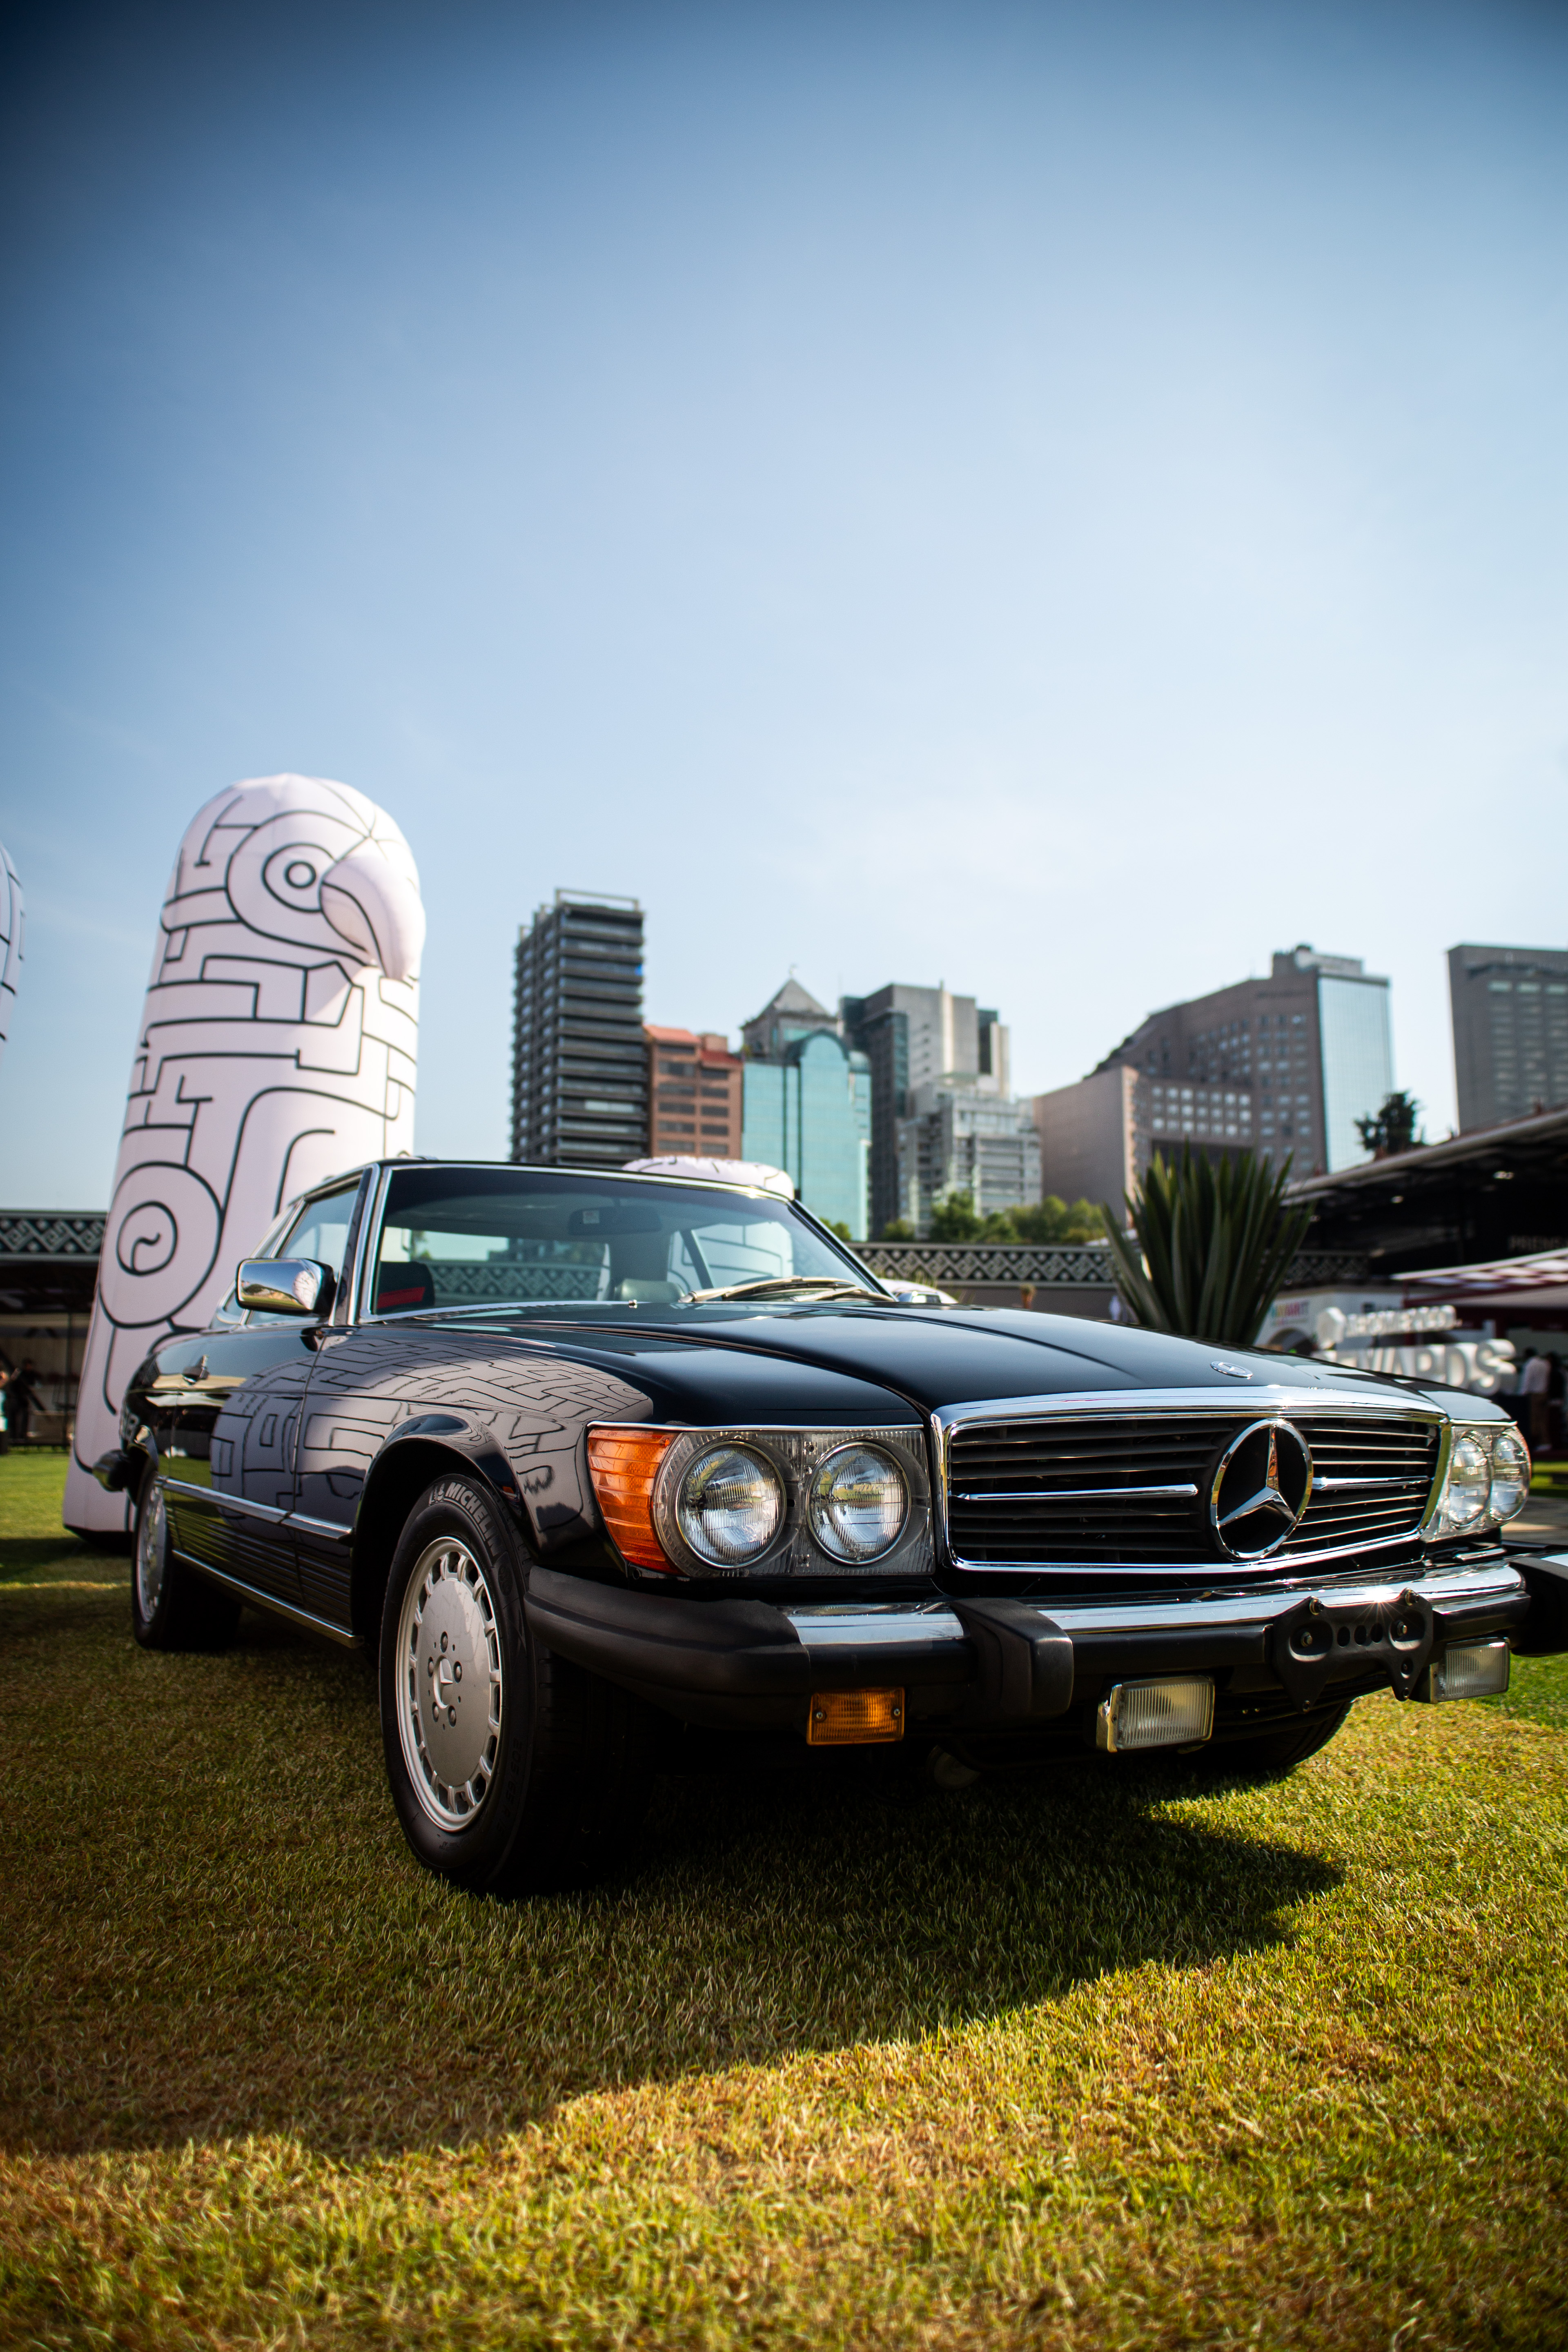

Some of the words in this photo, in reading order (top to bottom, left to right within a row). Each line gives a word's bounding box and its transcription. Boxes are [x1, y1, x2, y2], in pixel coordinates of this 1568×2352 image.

[1508, 1234, 1568, 1252] PRENS
[1311, 1339, 1516, 1395] WARDS
[445, 1482, 500, 1557] MICHELIN
